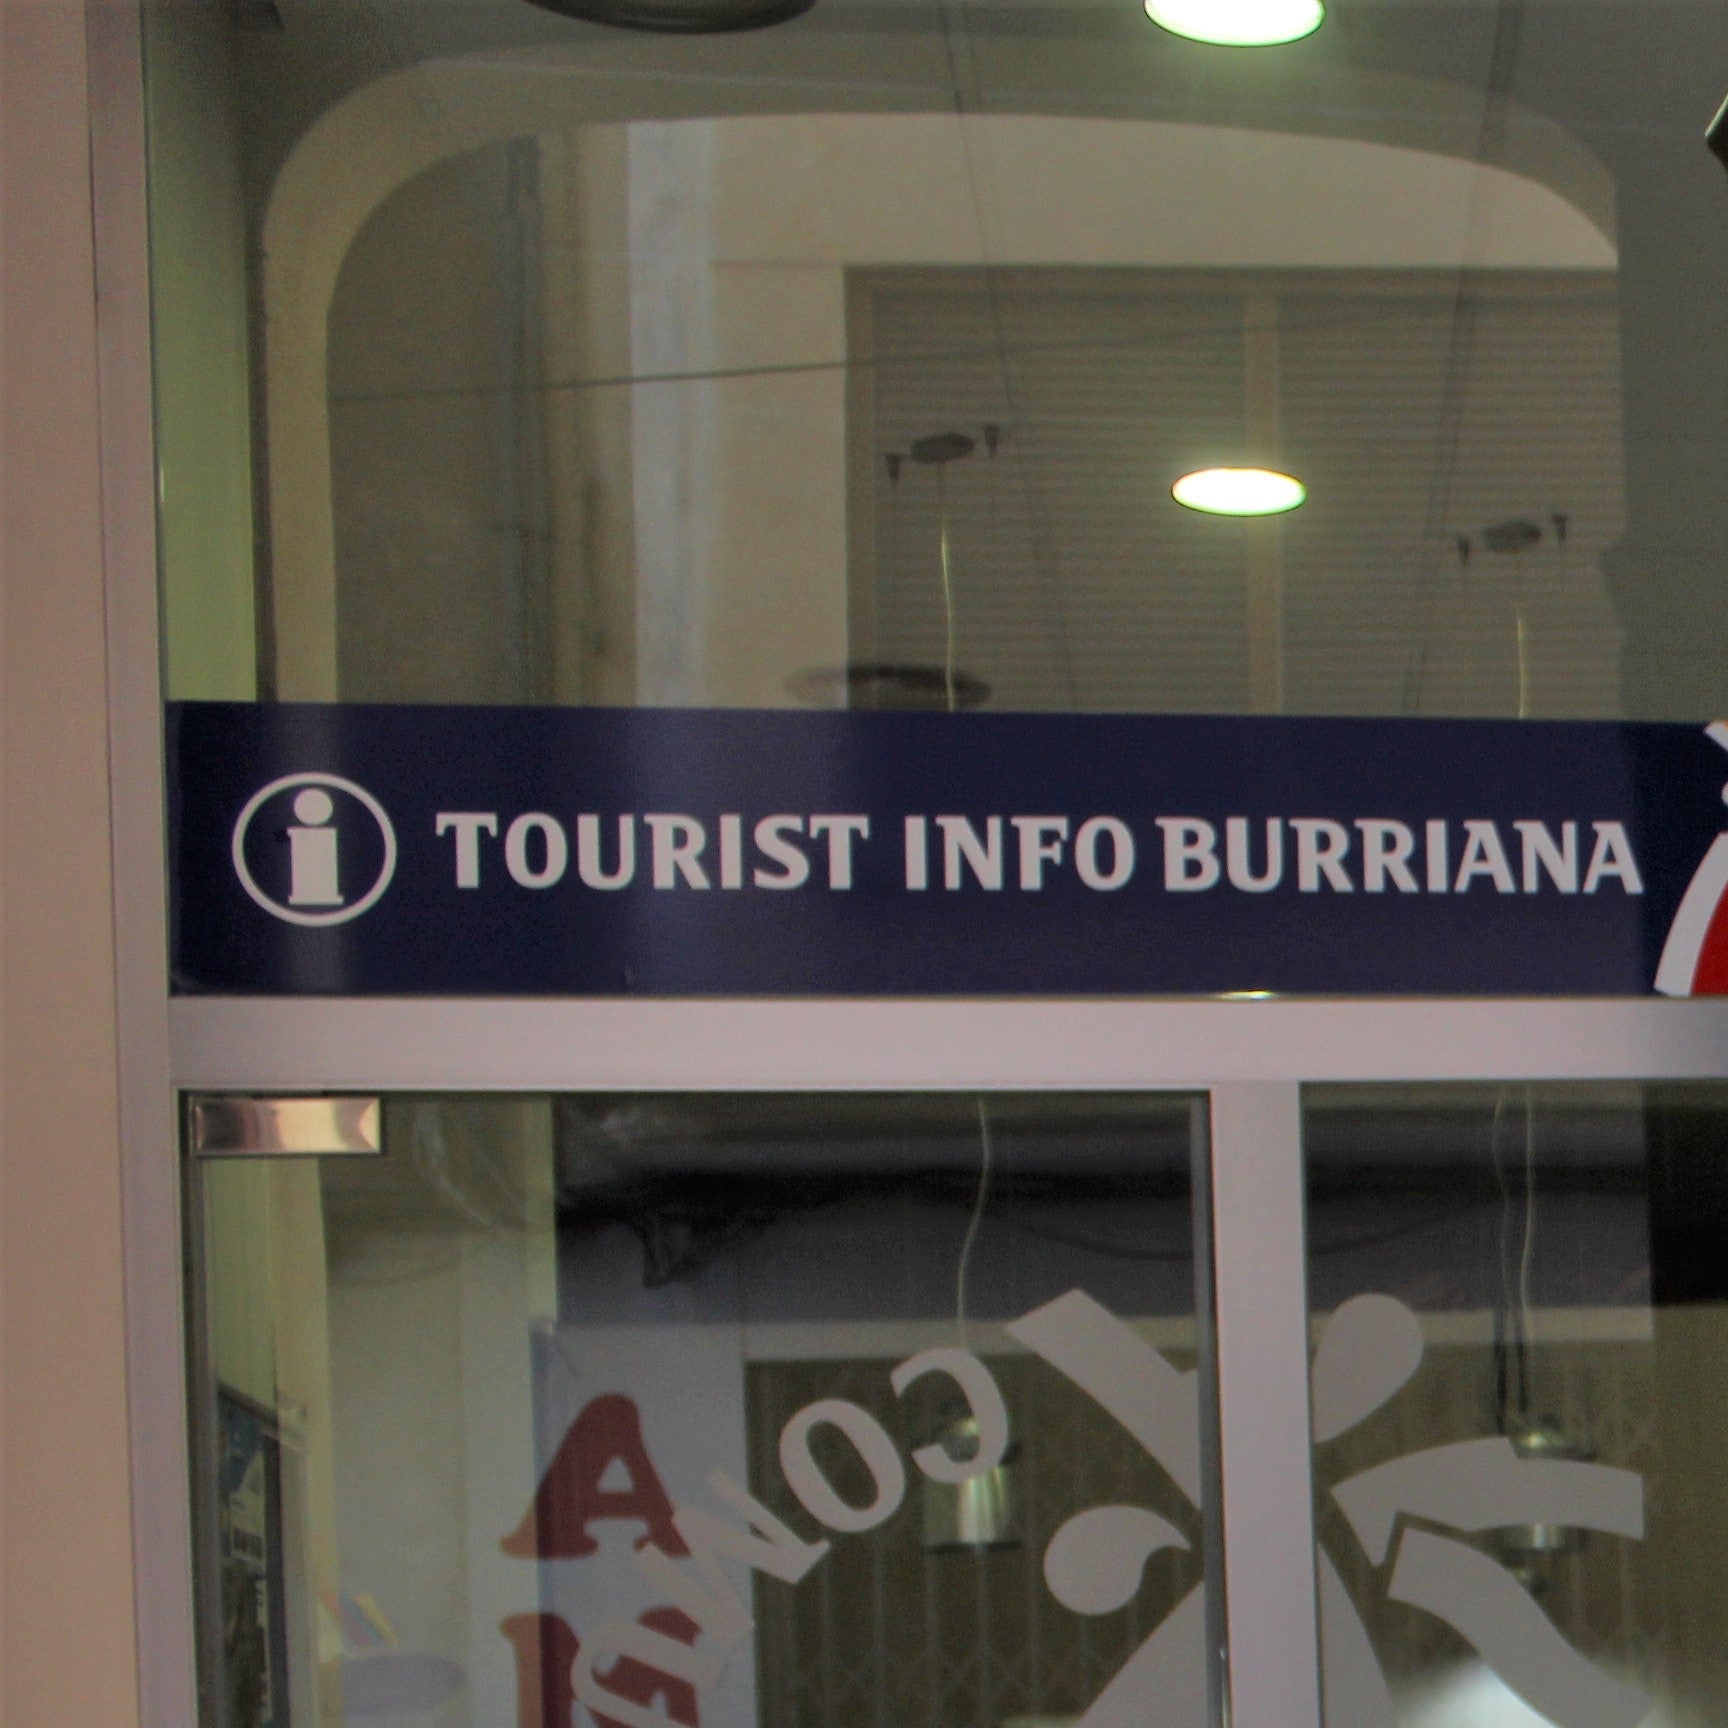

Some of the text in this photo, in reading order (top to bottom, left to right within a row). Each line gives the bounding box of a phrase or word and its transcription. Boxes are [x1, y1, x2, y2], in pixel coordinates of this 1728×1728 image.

[436, 811, 1644, 895] TOURIST INFO BURRIANA
